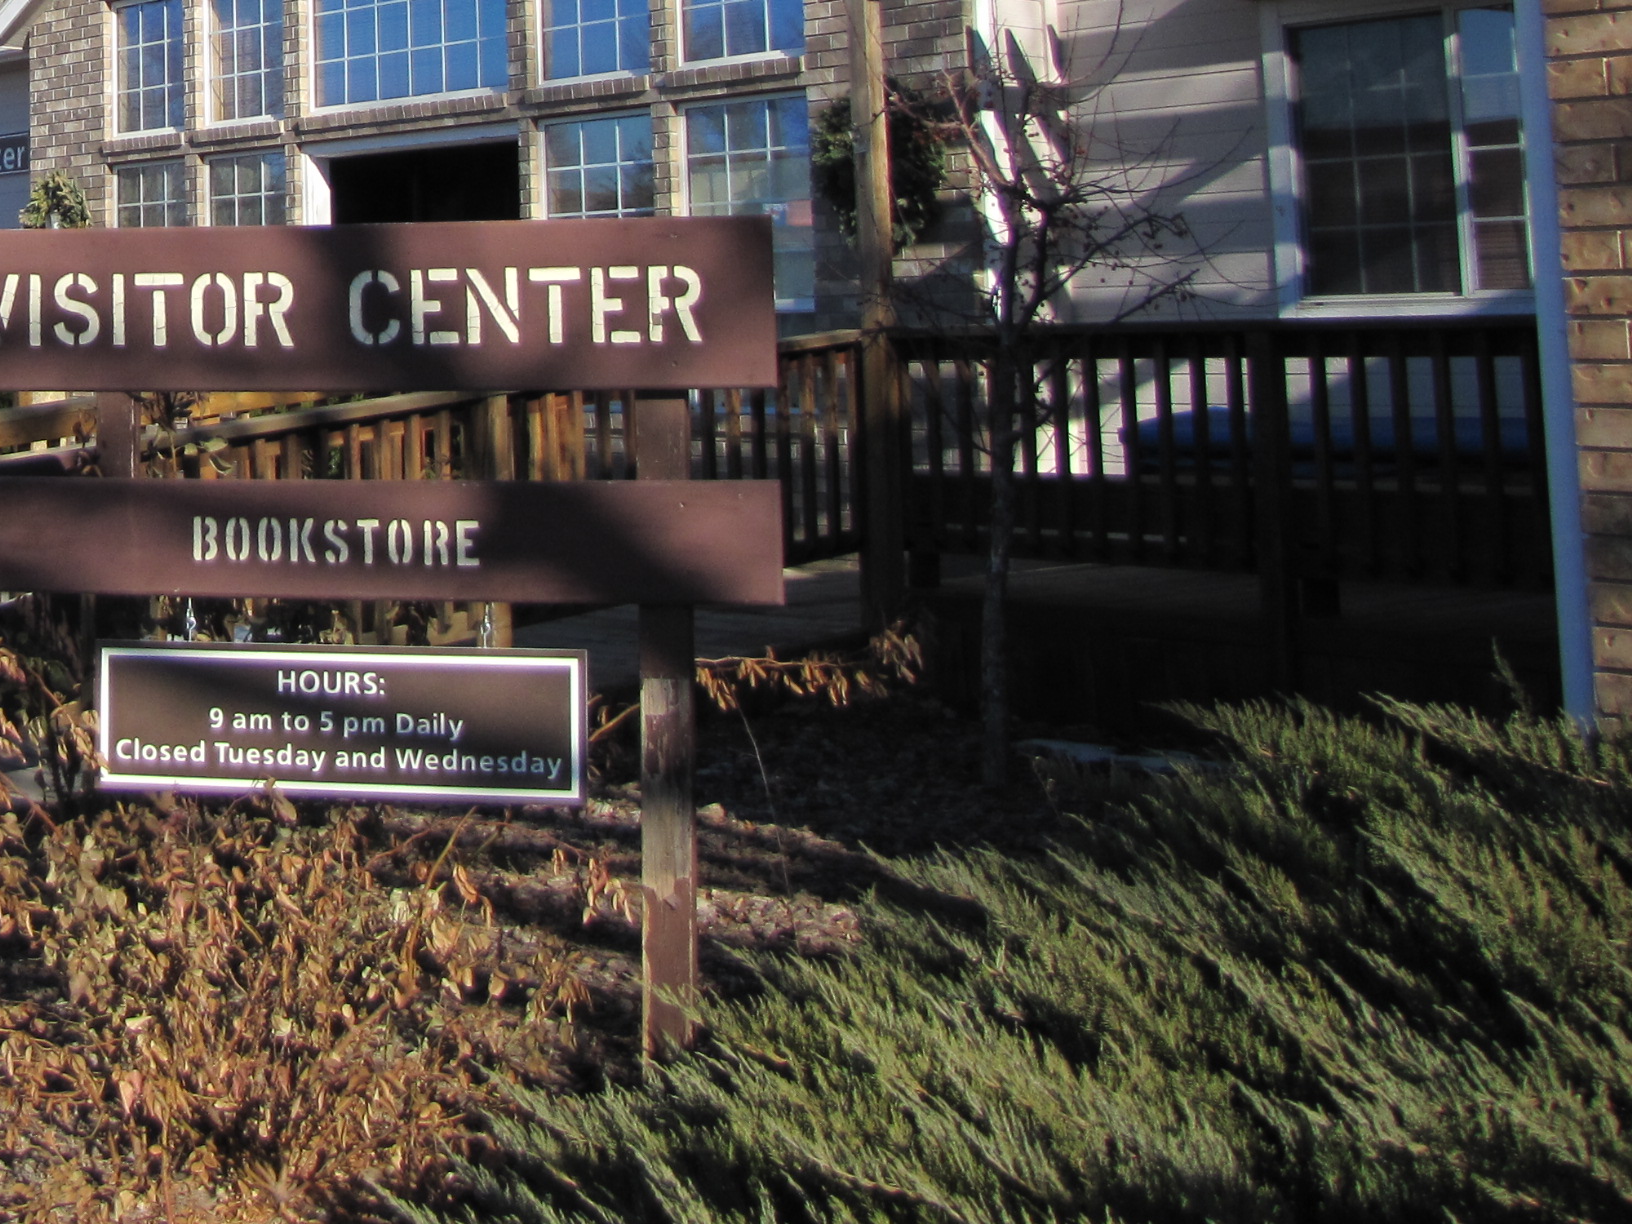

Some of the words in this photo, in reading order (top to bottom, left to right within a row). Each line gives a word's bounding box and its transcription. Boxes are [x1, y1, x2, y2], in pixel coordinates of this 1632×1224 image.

[347, 264, 705, 346] CENTER
[191, 514, 482, 567] BOOKSTORE
[277, 669, 386, 695] HOURS:
[208, 707, 224, 730] 9
[231, 710, 272, 731] am
[282, 712, 311, 732] to
[319, 711, 334, 733] 5
[342, 716, 386, 738] pm
[395, 713, 464, 742] Daily
[115, 737, 206, 764] Closed
[214, 741, 327, 772] Tuesday
[334, 745, 386, 769] and
[394, 748, 563, 778] Wednesday
